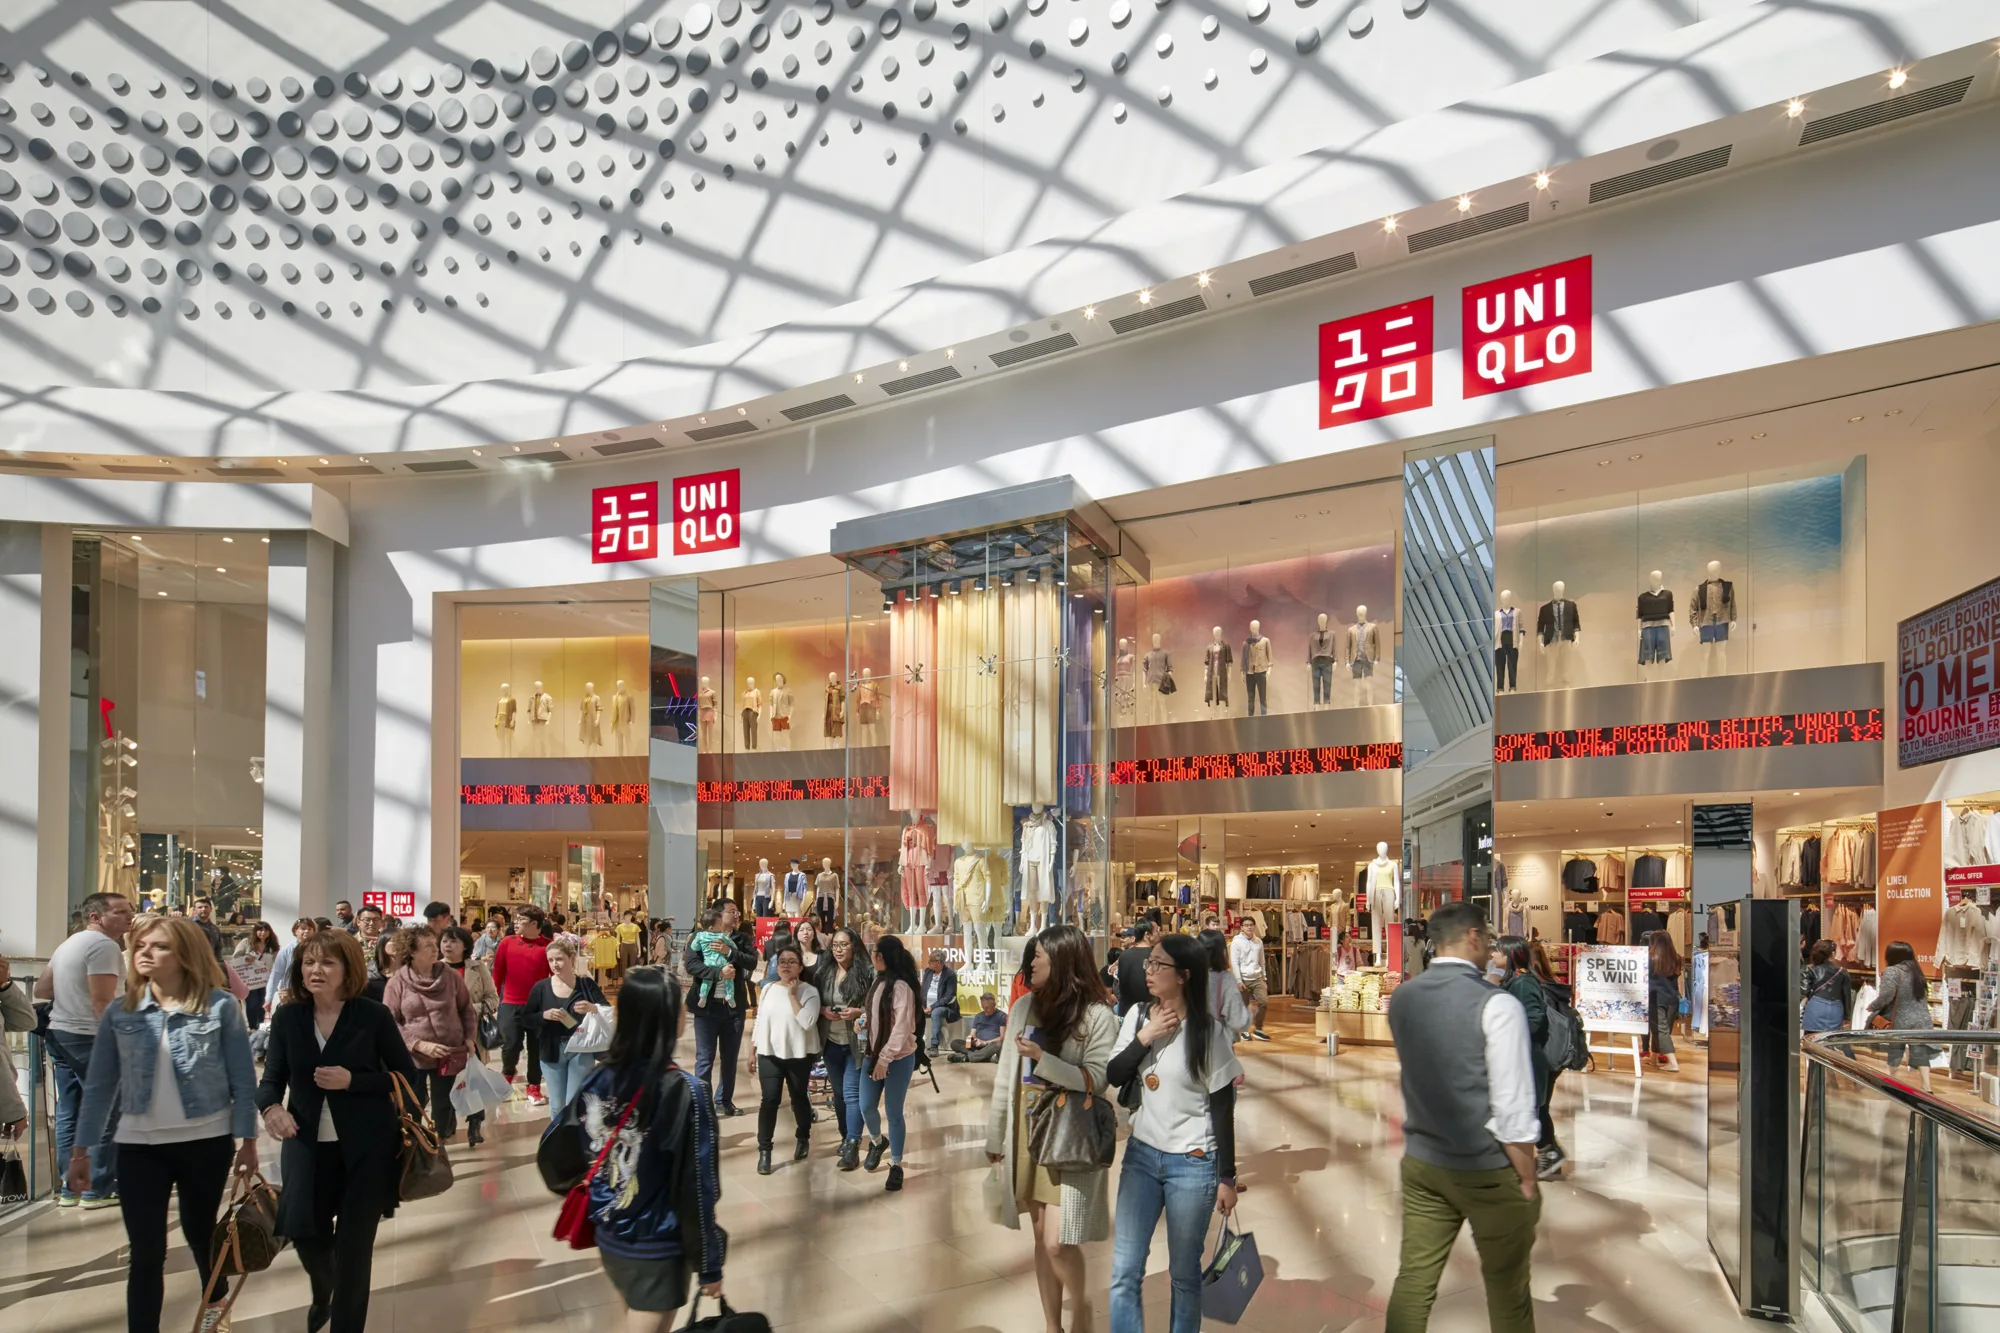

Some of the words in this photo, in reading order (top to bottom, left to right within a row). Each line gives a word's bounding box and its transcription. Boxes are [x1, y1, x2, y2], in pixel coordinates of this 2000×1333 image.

[1477, 277, 1566, 333] UNI
[1334, 316, 1417, 368] ユニ
[1477, 324, 1576, 384] QLO
[601, 492, 649, 522] ユニ
[680, 481, 727, 513] UNI
[680, 513, 732, 549] QLO
[1900, 613, 2000, 674] ELBOURNE
[1911, 627, 1926, 647] TO
[1900, 671, 1924, 716] O
[1499, 732, 1536, 749] COME
[1546, 731, 1565, 747] TO
[1575, 728, 1602, 744] THE
[1613, 723, 1667, 742] BIGGER
[1678, 720, 1709, 738] AND
[1720, 715, 1783, 735] BETTER
[1795, 710, 1856, 730] UNIQLO
[1900, 697, 1981, 743] BOURNE
[1522, 744, 1551, 761] AND
[1561, 741, 1617, 759] SUPIMA
[1626, 737, 1689, 755] COTTON
[1702, 731, 1771, 750] TSHIRTS
[1782, 729, 1794, 746] 2
[1806, 726, 1839, 745] FOR
[1910, 739, 1920, 751] TO
[1922, 725, 1973, 748] MELBOURNE
[1127, 770, 1147, 784] LKE
[1153, 768, 1200, 782] PREMIUM
[1206, 766, 1235, 780] LINEN
[1242, 762, 1283, 778] SHIRTS
[1353, 756, 1390, 771] CHINO
[1146, 758, 1160, 771] TO
[1166, 757, 1186, 769] THE
[1192, 754, 1230, 768] BIGGER
[1237, 752, 1259, 766] AND
[1266, 749, 1309, 764] BETTER
[1316, 745, 1359, 760] UNIQLO
[475, 785, 527, 796] CHADSTONE!
[540, 784, 580, 796] WELCOME
[585, 784, 596, 795] TO
[601, 784, 616, 795] THE
[621, 783, 649, 795] BIGGER
[736, 789, 767, 802] SUPIMA
[771, 788, 804, 801] COTTON
[809, 788, 844, 800] TSHIRTS
[848, 787, 854, 799] 2
[859, 786, 875, 798] FOR
[743, 779, 793, 792] CHADSTONE!
[806, 777, 846, 791] WELCOME
[851, 777, 862, 788] TO
[867, 776, 883, 788] THE
[466, 794, 504, 805] PREMIUM
[508, 794, 530, 805] LINEN
[535, 794, 565, 805] SHIRTS
[613, 793, 636, 804] CHINO
[1886, 875, 1908, 886] LINEN
[1947, 873, 1966, 881] SPECIAL
[1967, 871, 1983, 880] OFFER
[393, 894, 411, 905] UNI
[1886, 887, 1931, 900] COLLECTION
[393, 904, 413, 916] QLO
[1586, 957, 1638, 972] SPEND
[1586, 971, 1598, 982] &
[1602, 970, 1638, 984] WIN!
